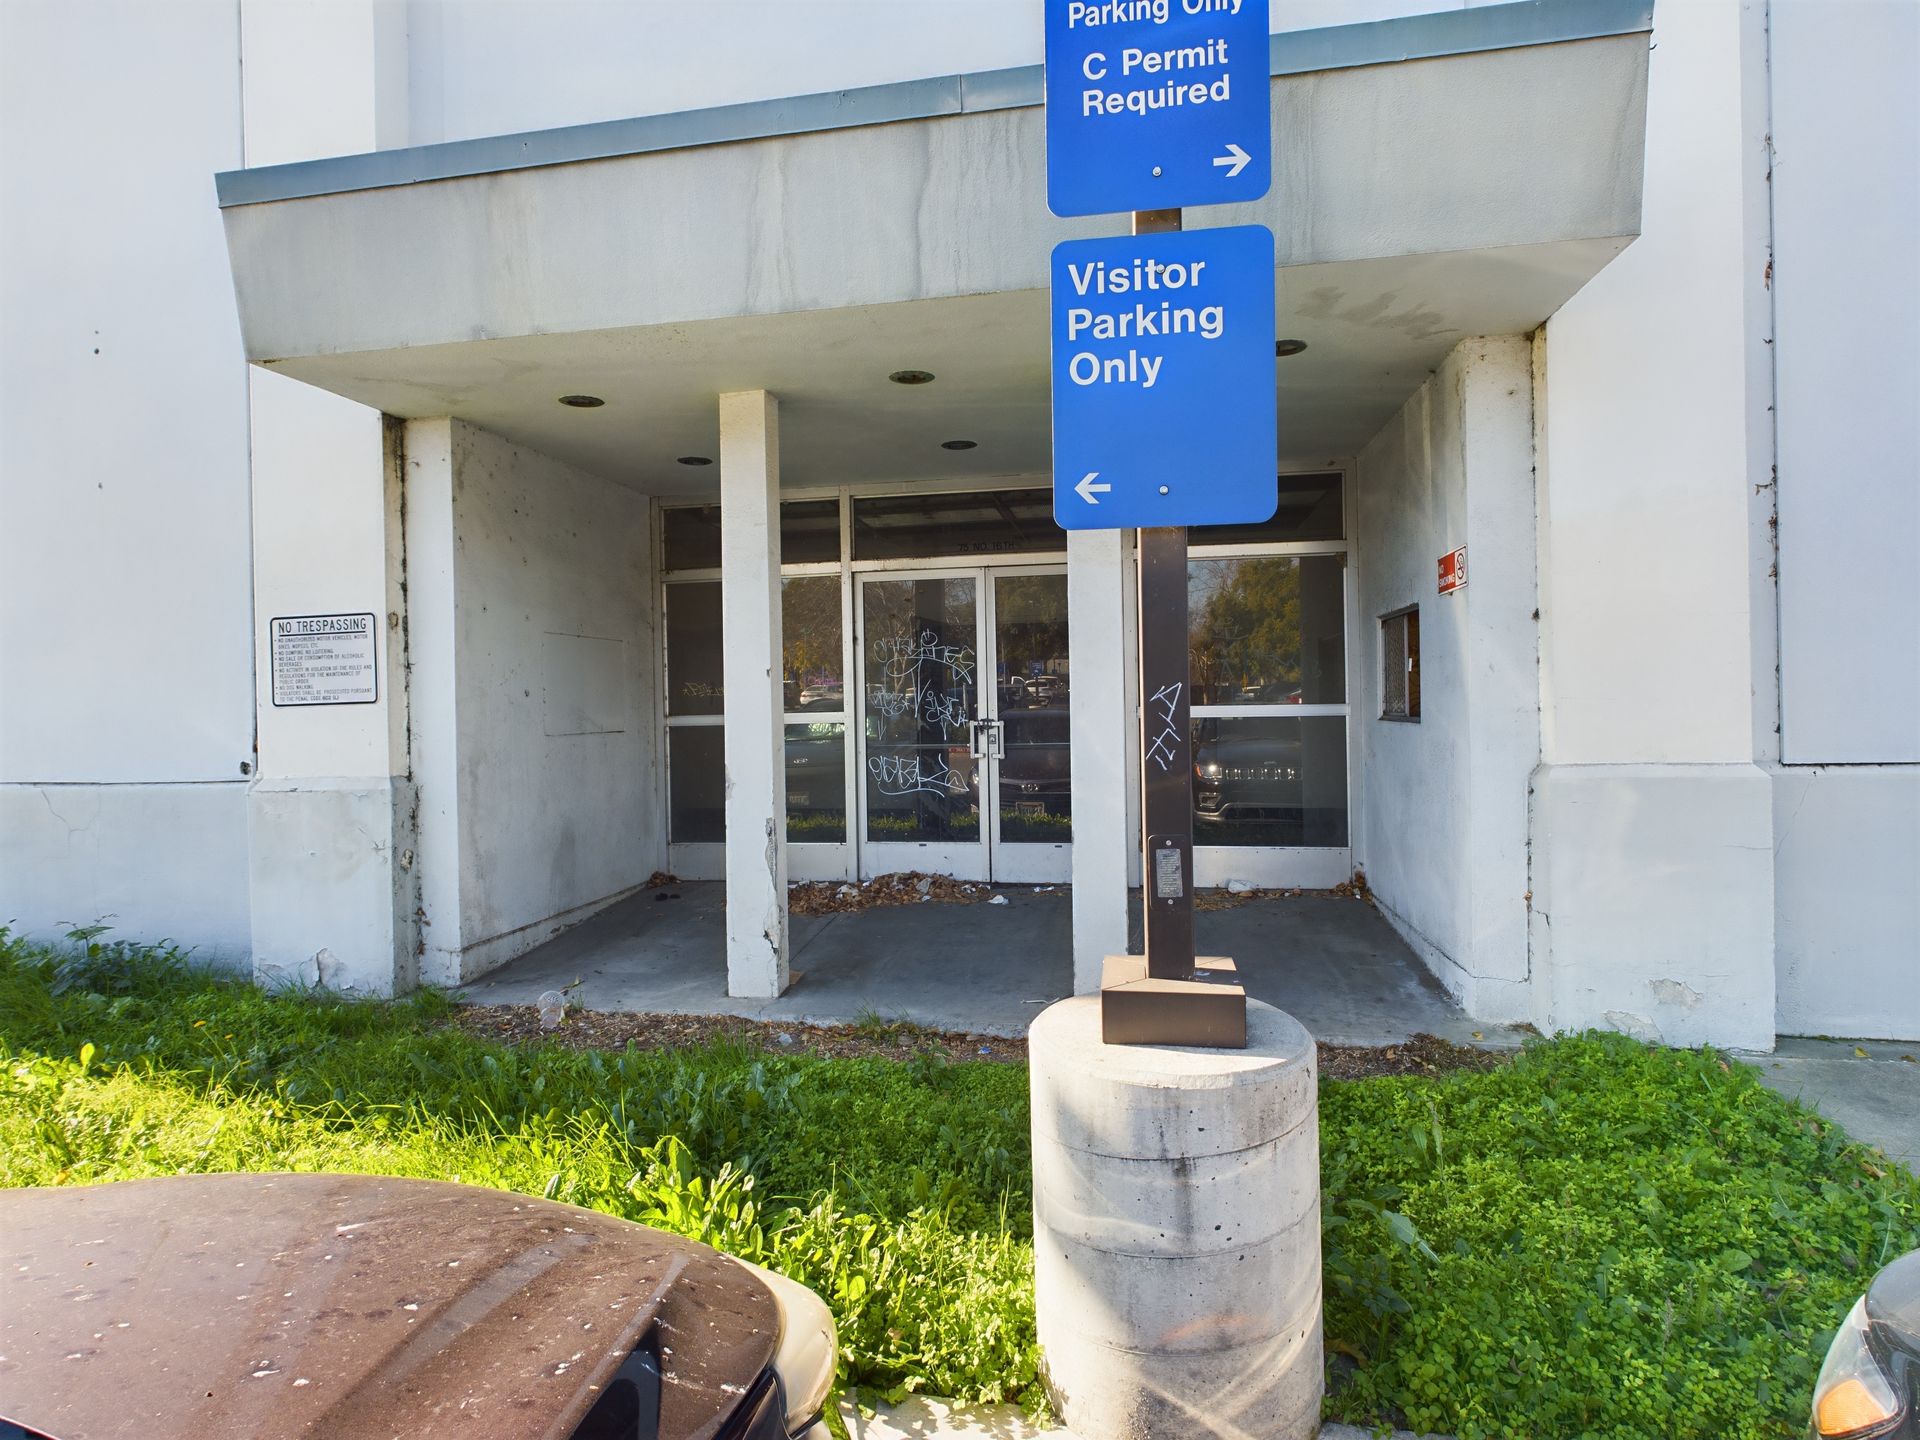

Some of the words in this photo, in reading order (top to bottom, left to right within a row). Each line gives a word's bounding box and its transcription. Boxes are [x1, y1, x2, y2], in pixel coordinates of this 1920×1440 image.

[1068, 0, 1169, 29] Parking
[1082, 53, 1107, 80] C
[1122, 39, 1229, 76] Permit
[1082, 74, 1230, 117] Required
[1068, 258, 1205, 295] Visitor
[1068, 302, 1223, 341] Parking
[1069, 350, 1163, 388] Only
[278, 622, 292, 633] NO
[297, 618, 366, 632] TRESPASSING
